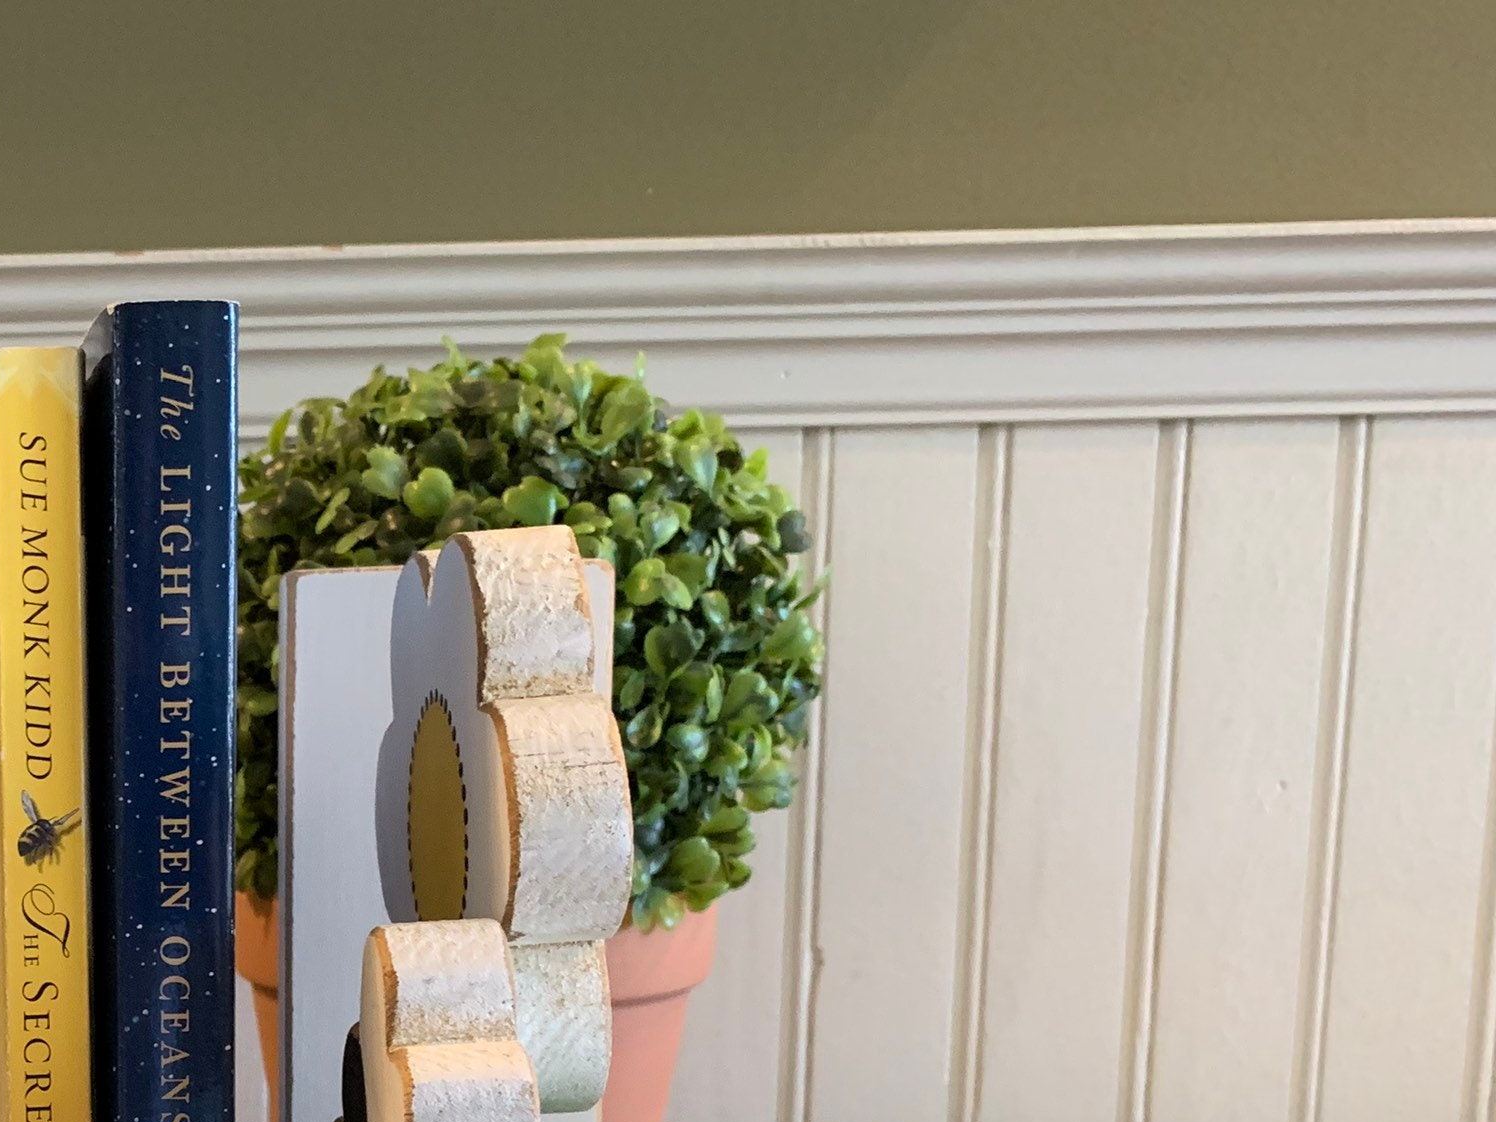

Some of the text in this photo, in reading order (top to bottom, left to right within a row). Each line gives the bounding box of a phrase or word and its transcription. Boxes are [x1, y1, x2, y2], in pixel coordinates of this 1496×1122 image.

[159, 363, 196, 442] The
[18, 432, 54, 781] SUE MONK KIDD
[158, 465, 196, 637] LIGHT
[158, 663, 194, 912] BETWEEN
